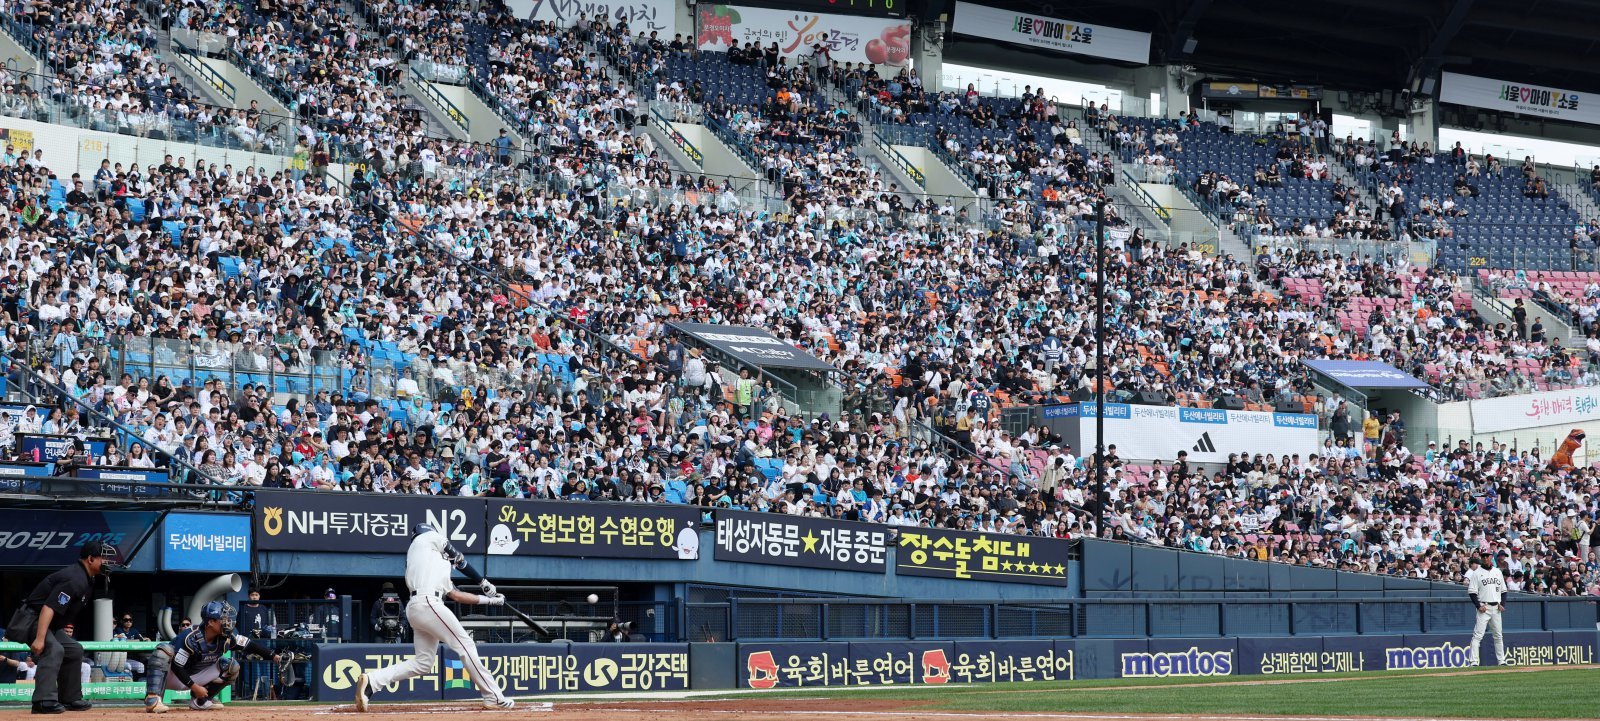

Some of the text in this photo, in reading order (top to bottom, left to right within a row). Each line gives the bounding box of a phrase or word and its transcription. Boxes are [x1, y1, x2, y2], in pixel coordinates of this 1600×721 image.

[1470, 257, 1486, 266] 224
[977, 400, 987, 408] 93
[1045, 405, 1315, 425] 두산에너빌리티 두산너빌리티 두산에너빌리티 두산에너빌리티 두산에너빌리티 두산에너빌리티
[287, 510, 408, 537] NH투자증권
[498, 505, 675, 547] Sh 수협보험 수협은행
[28, 531, 74, 550] 리그
[169, 533, 246, 552] 두산에너빌리티
[717, 518, 799, 557] 태성자동문
[899, 532, 1030, 578] 장수돌침대
[1122, 646, 1232, 677] mentos
[1260, 651, 1364, 674] 상쾌함엔 언제나
[1504, 645, 1593, 666] 상쾌함엔 언제나
[621, 653, 688, 690] 금강주택
